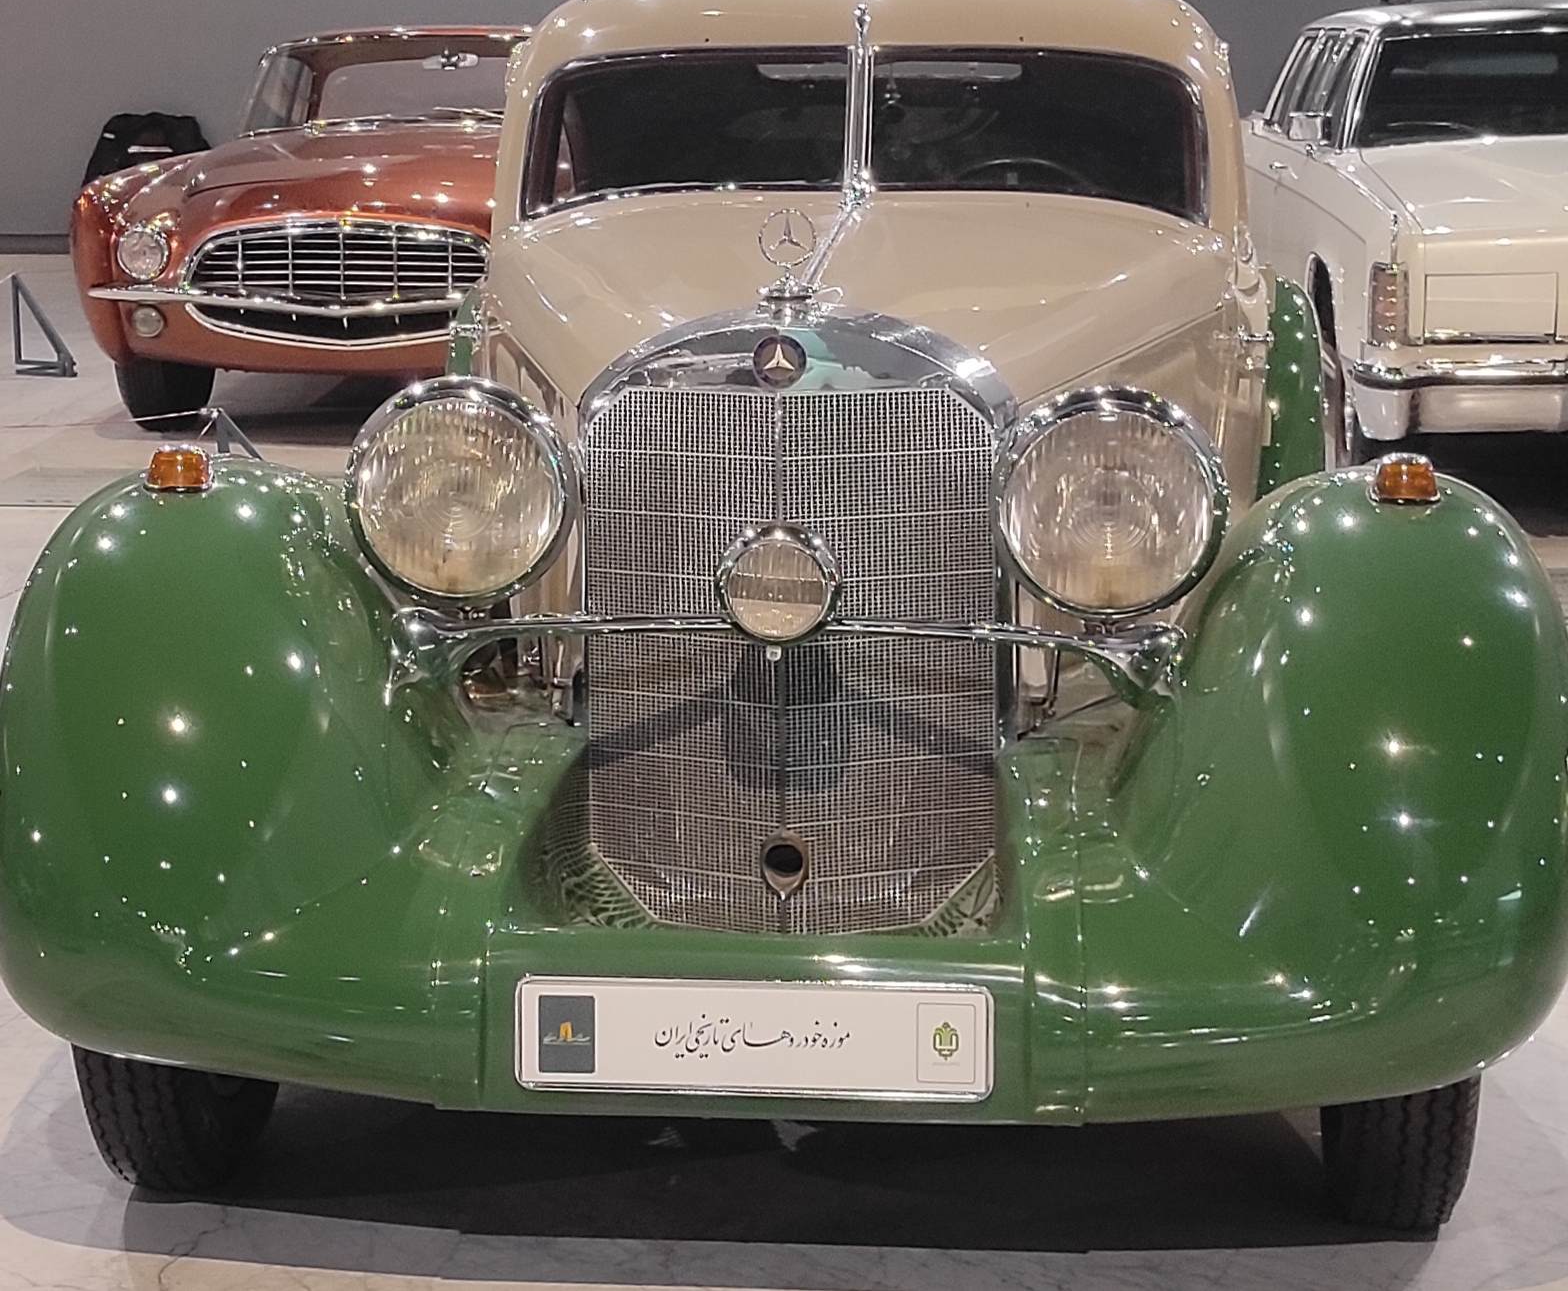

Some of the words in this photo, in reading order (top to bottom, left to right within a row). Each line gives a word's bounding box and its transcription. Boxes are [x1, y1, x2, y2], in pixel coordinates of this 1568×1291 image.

[654, 1021, 693, 1059] ایران
[685, 1013, 730, 1059] تاریخی
[821, 1021, 851, 1049] موزه
